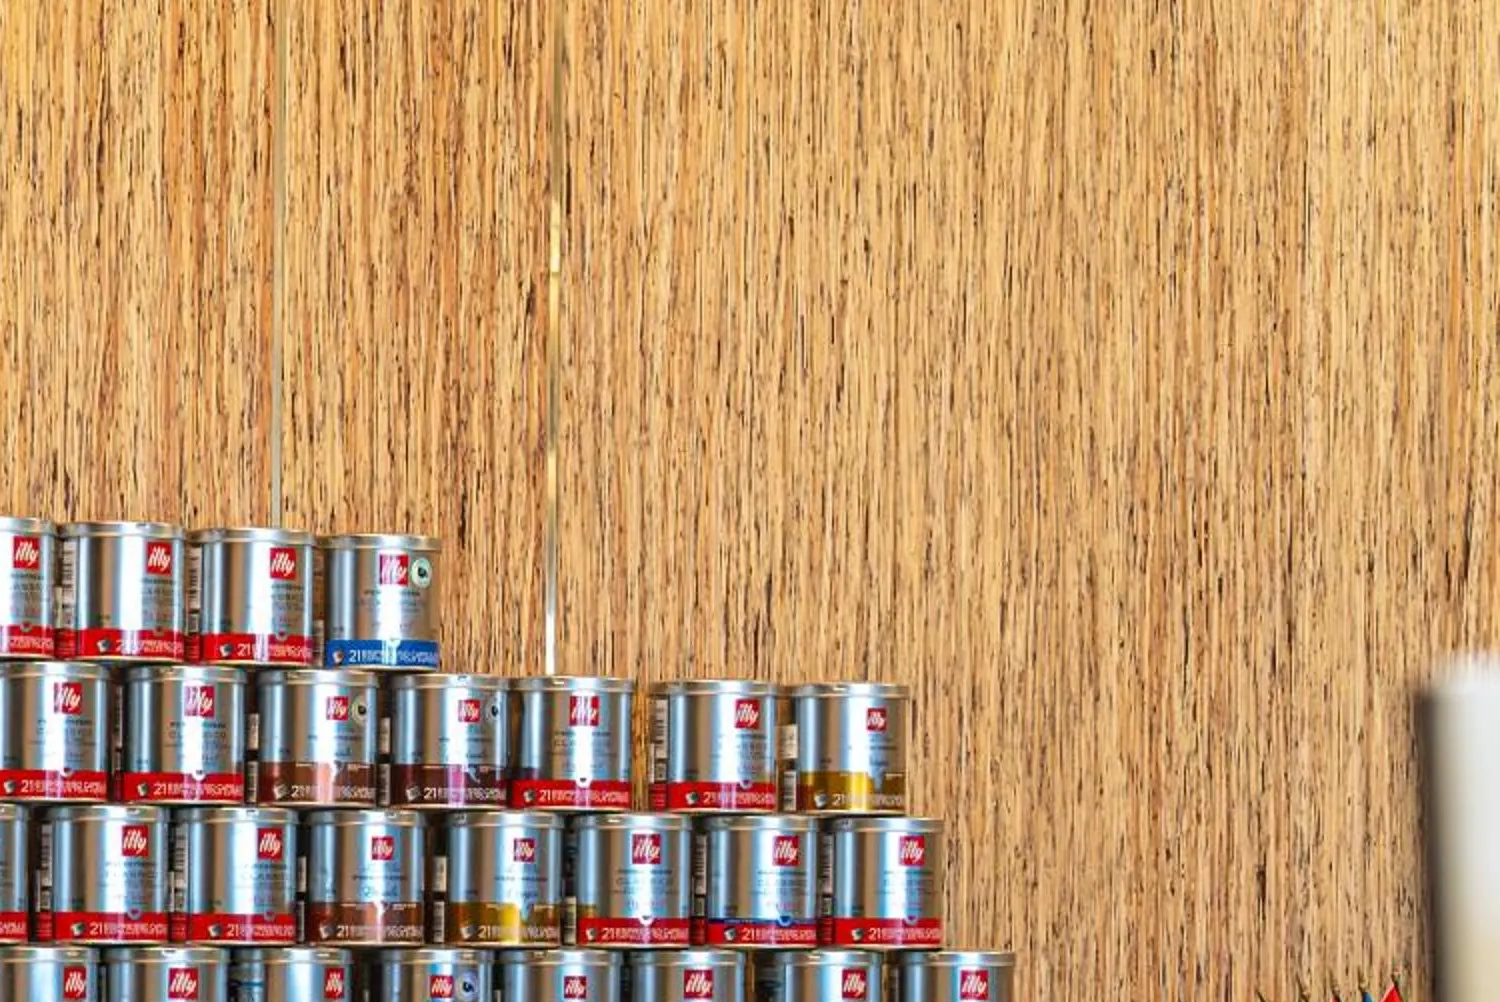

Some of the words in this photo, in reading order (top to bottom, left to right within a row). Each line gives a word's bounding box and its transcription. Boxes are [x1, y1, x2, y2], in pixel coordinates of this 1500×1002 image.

[15, 541, 37, 566] illy
[149, 547, 170, 572] illy
[271, 552, 294, 577] illy
[55, 687, 80, 711] illy
[328, 699, 347, 718] illy
[459, 703, 479, 720] illy
[736, 703, 758, 727] illy
[868, 711, 885, 730] illy
[123, 830, 147, 854] illy
[259, 832, 281, 857] illy
[373, 840, 392, 858] illy
[515, 841, 534, 861] illy
[633, 838, 659, 862] illy
[774, 840, 799, 863] illy
[901, 840, 923, 863] illy
[65, 971, 85, 996] illy
[170, 972, 197, 997] illy
[325, 972, 343, 996] illy
[432, 979, 452, 996] illy
[565, 979, 585, 997] illy
[685, 974, 712, 997] illy
[843, 974, 866, 997] illy
[962, 974, 987, 997] illy
